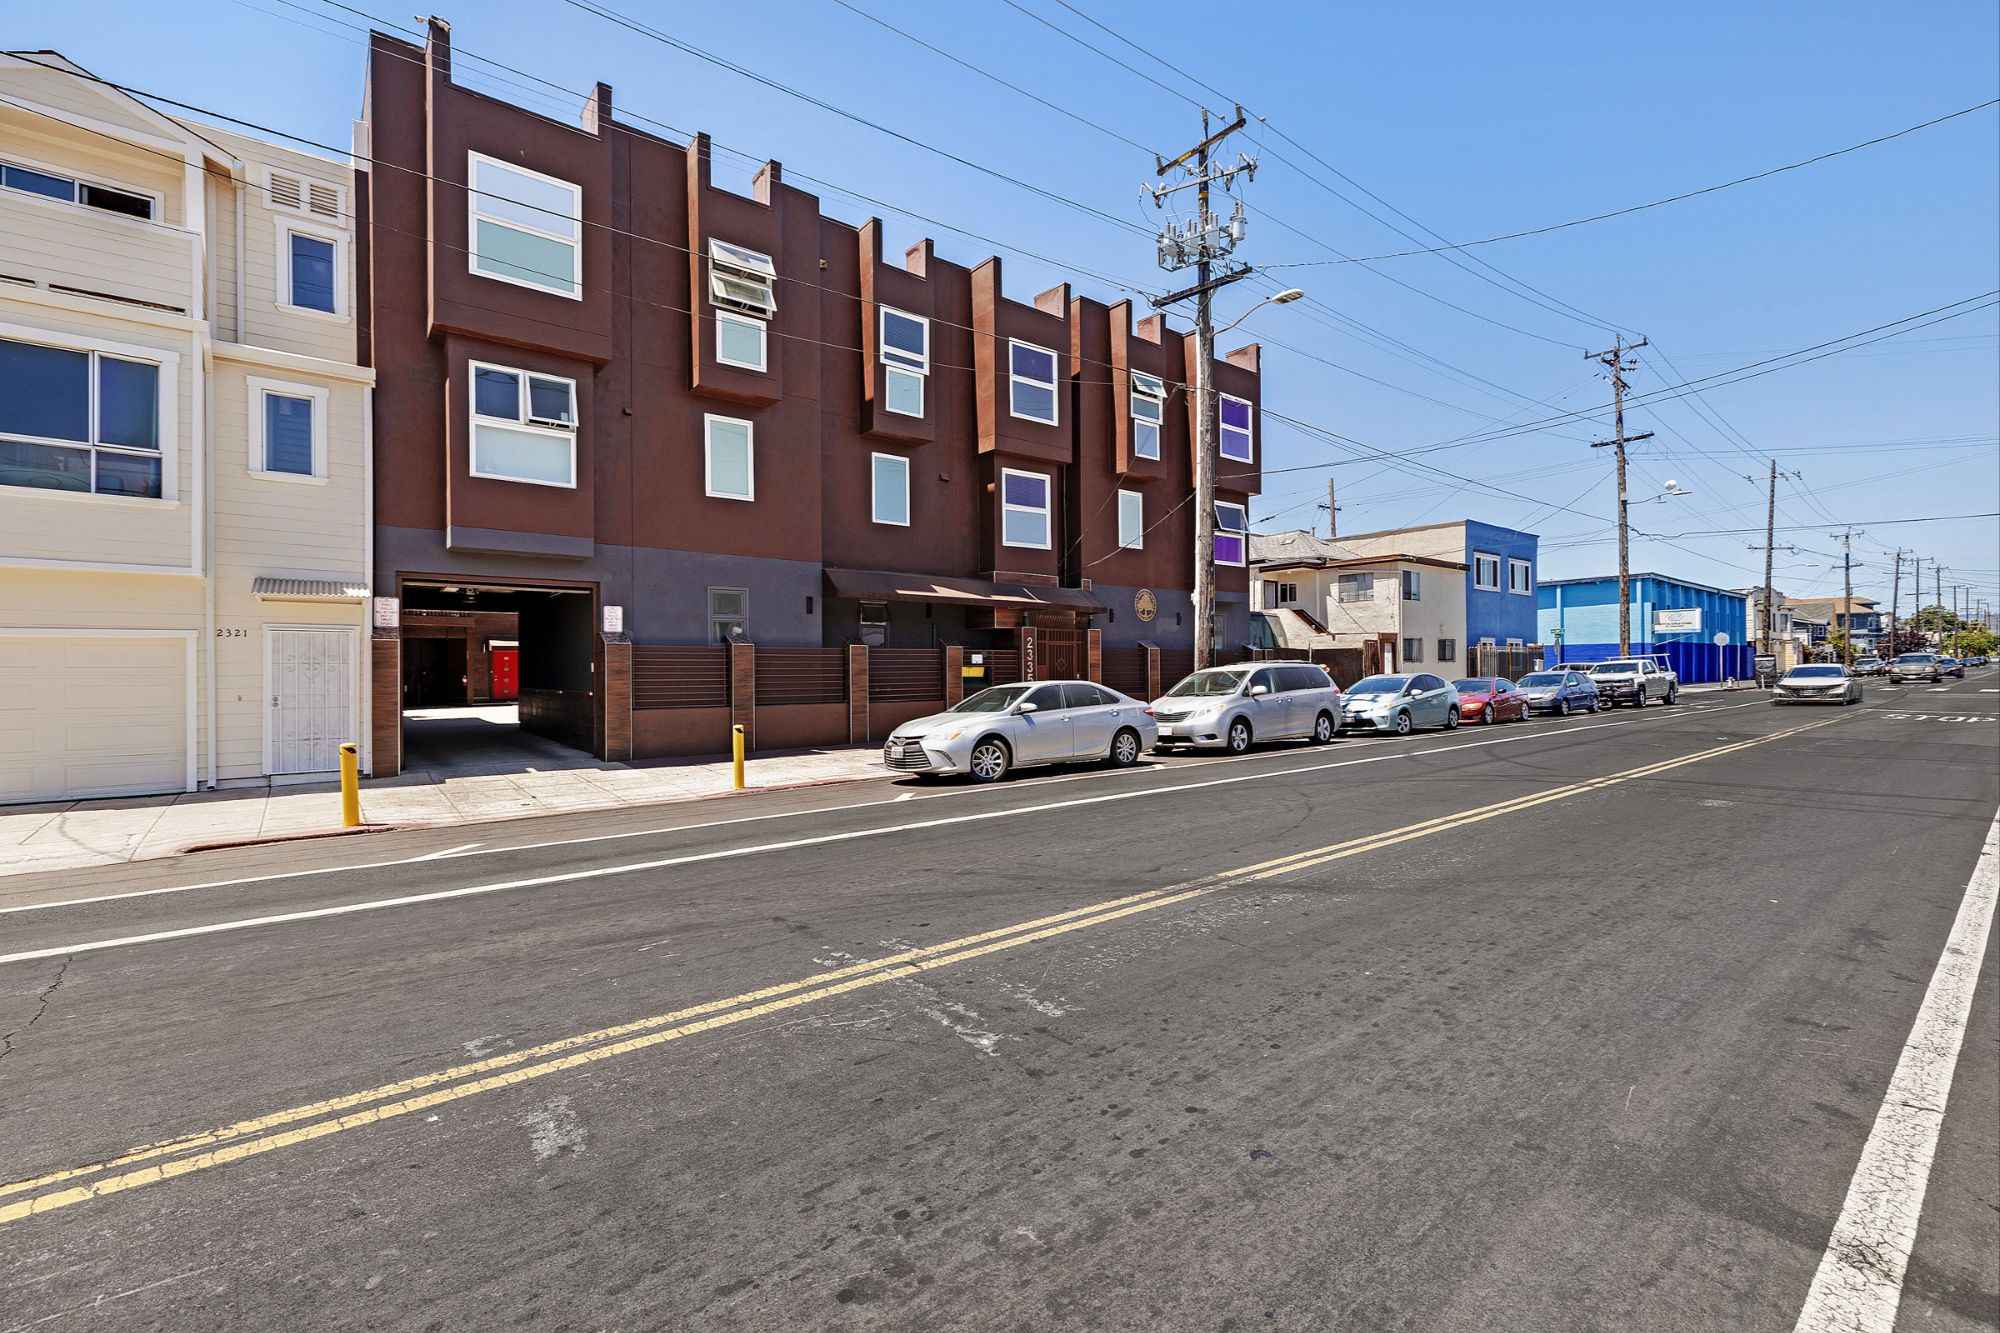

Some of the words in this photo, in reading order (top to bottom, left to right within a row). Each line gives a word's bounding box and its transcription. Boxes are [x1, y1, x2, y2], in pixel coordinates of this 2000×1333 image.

[216, 628, 247, 638] 2321
[1026, 637, 1034, 682] 2335
[1880, 713, 1997, 723] STOP
